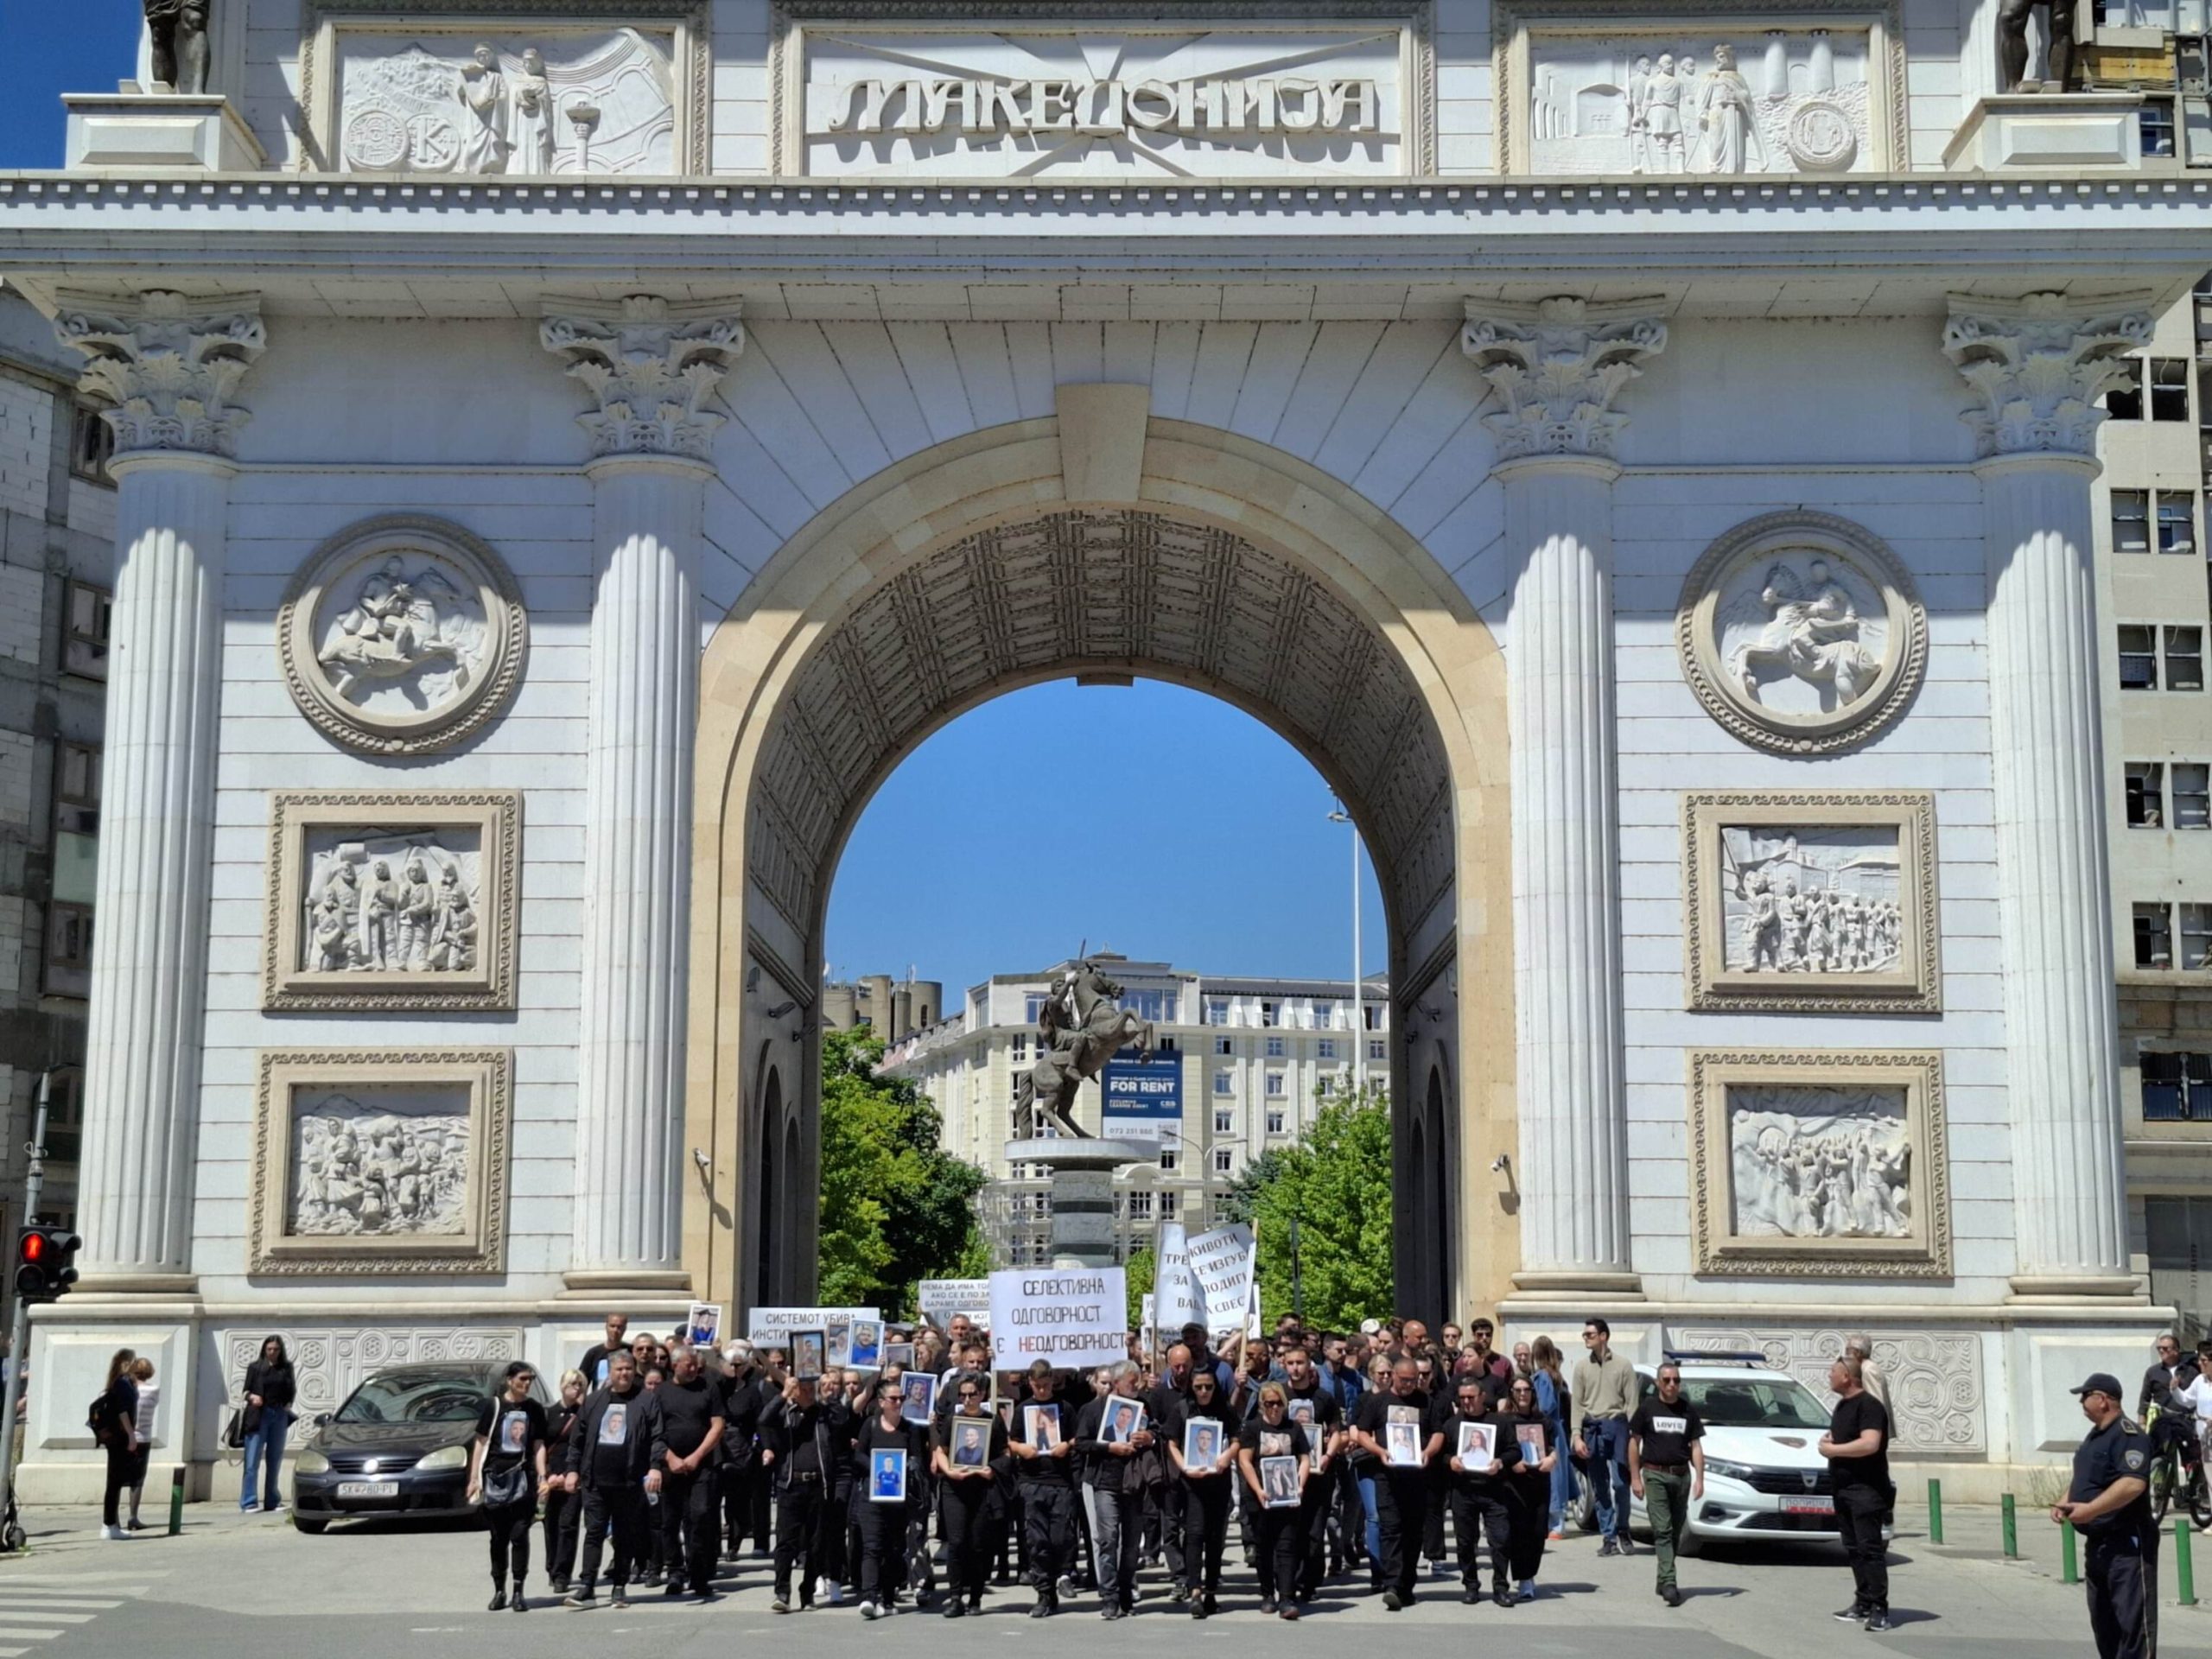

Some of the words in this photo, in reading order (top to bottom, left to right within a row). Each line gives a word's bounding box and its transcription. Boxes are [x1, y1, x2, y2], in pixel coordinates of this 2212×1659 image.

[829, 78, 1376, 137] МАКЕДОНИЈА
[1109, 1081, 1137, 1092] FOR
[1141, 1082, 1175, 1092] RENT
[1023, 1277, 1105, 1296] СЕЛЕКТИВНА
[1173, 1275, 1188, 1286] ЗА
[1215, 1295, 1245, 1313] СВЕС
[766, 1313, 820, 1324] СИСТЕМОТ
[1011, 1306, 1102, 1325] ОДГОВОРНОСТ
[1019, 1332, 1126, 1353] НЕОДГОВОРНОСТ
